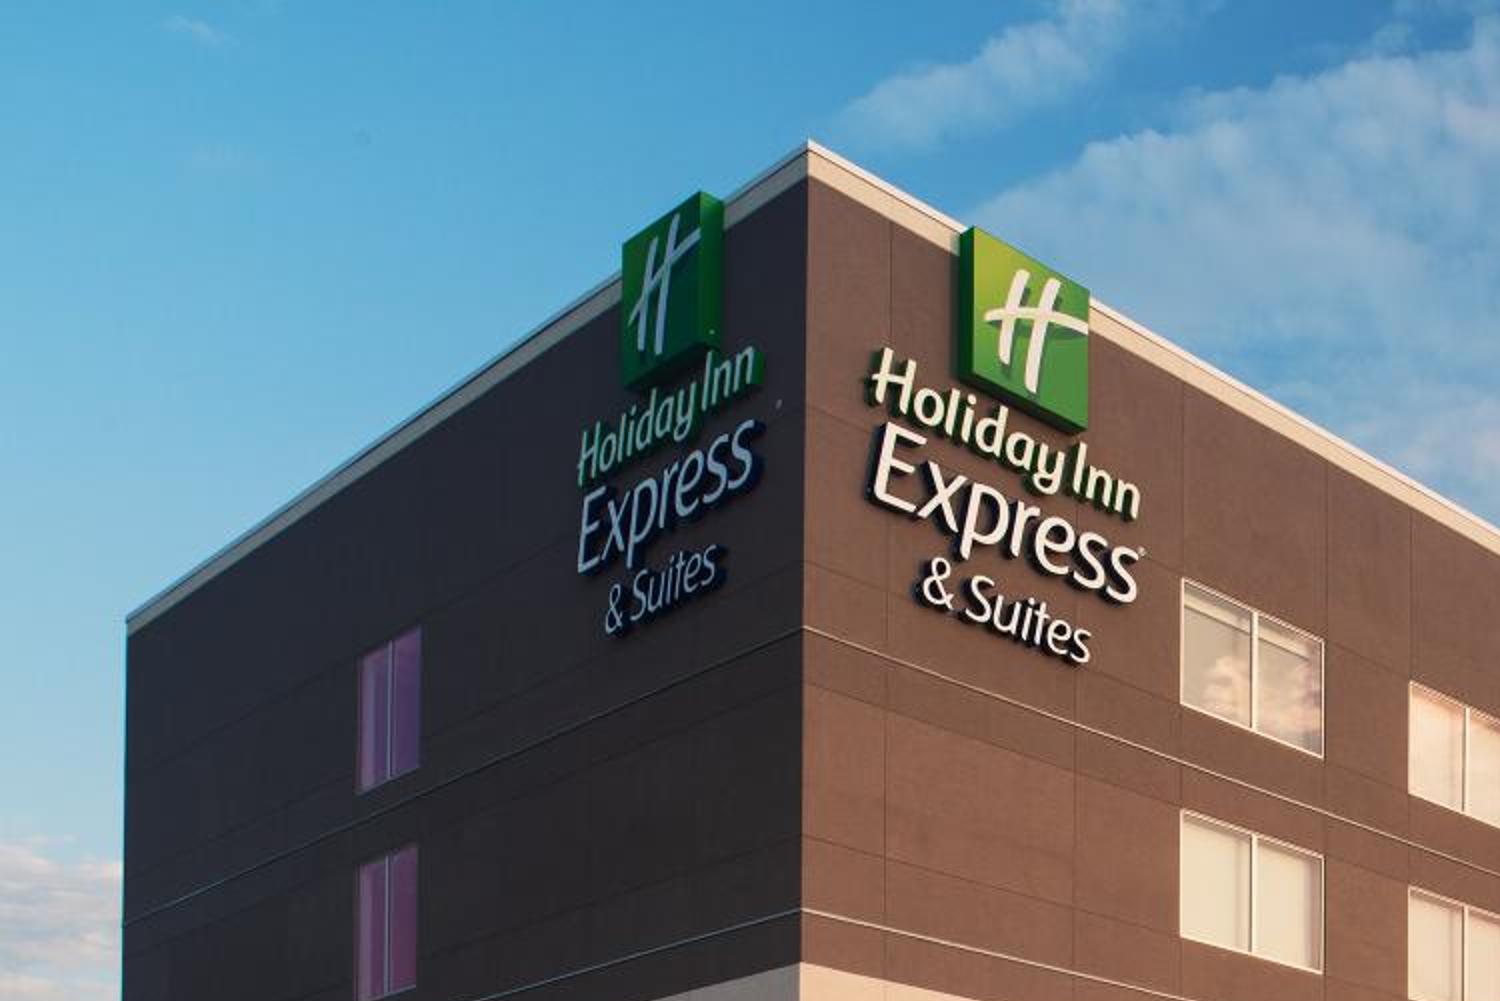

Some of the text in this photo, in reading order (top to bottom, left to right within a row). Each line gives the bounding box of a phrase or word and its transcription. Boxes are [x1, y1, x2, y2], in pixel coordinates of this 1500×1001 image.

[629, 213, 702, 355] H
[983, 269, 1089, 394] H
[577, 345, 755, 488] Holiday Inn
[871, 346, 1141, 520] Holiday Inn
[577, 418, 755, 574] Express
[871, 421, 1139, 604] Express
[605, 544, 717, 635] & Suites
[922, 556, 1092, 664] & Suites
